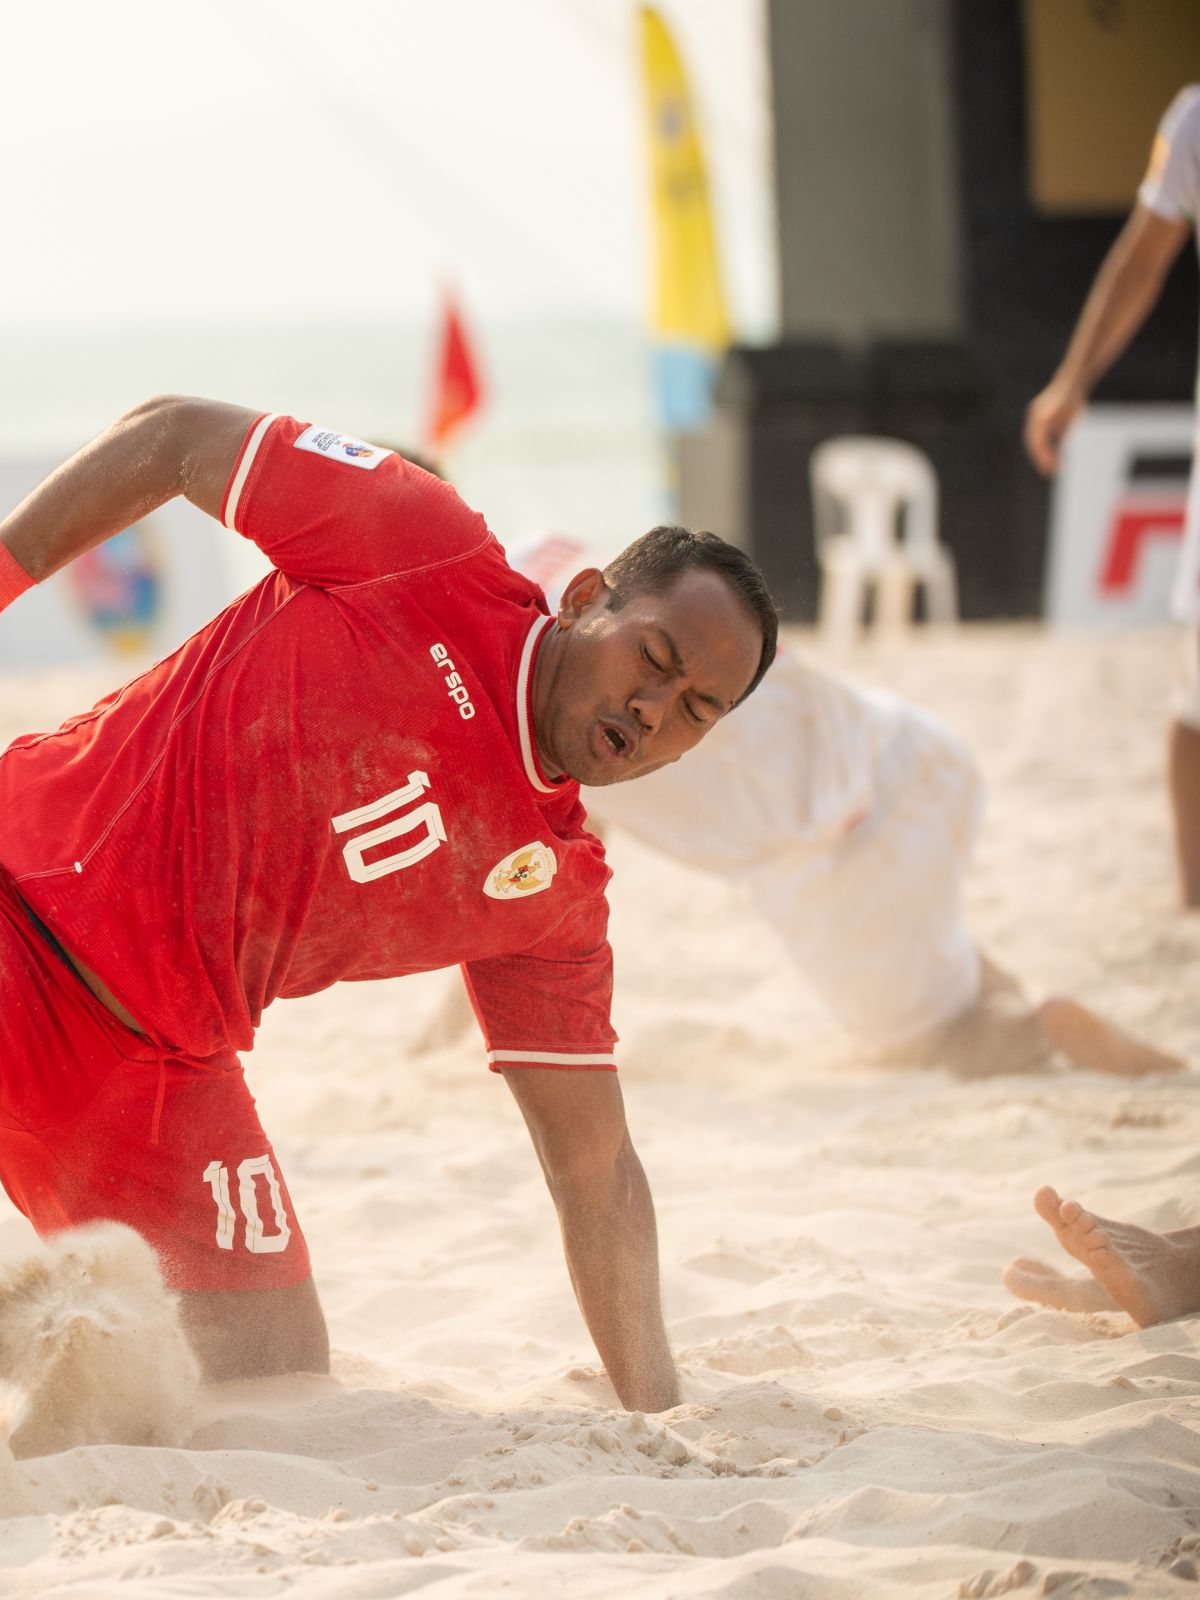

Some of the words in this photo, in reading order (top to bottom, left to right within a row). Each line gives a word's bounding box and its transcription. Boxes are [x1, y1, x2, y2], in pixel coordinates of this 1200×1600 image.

[430, 642, 476, 720] erspo
[331, 769, 448, 884] 10
[202, 1153, 291, 1255] 10
